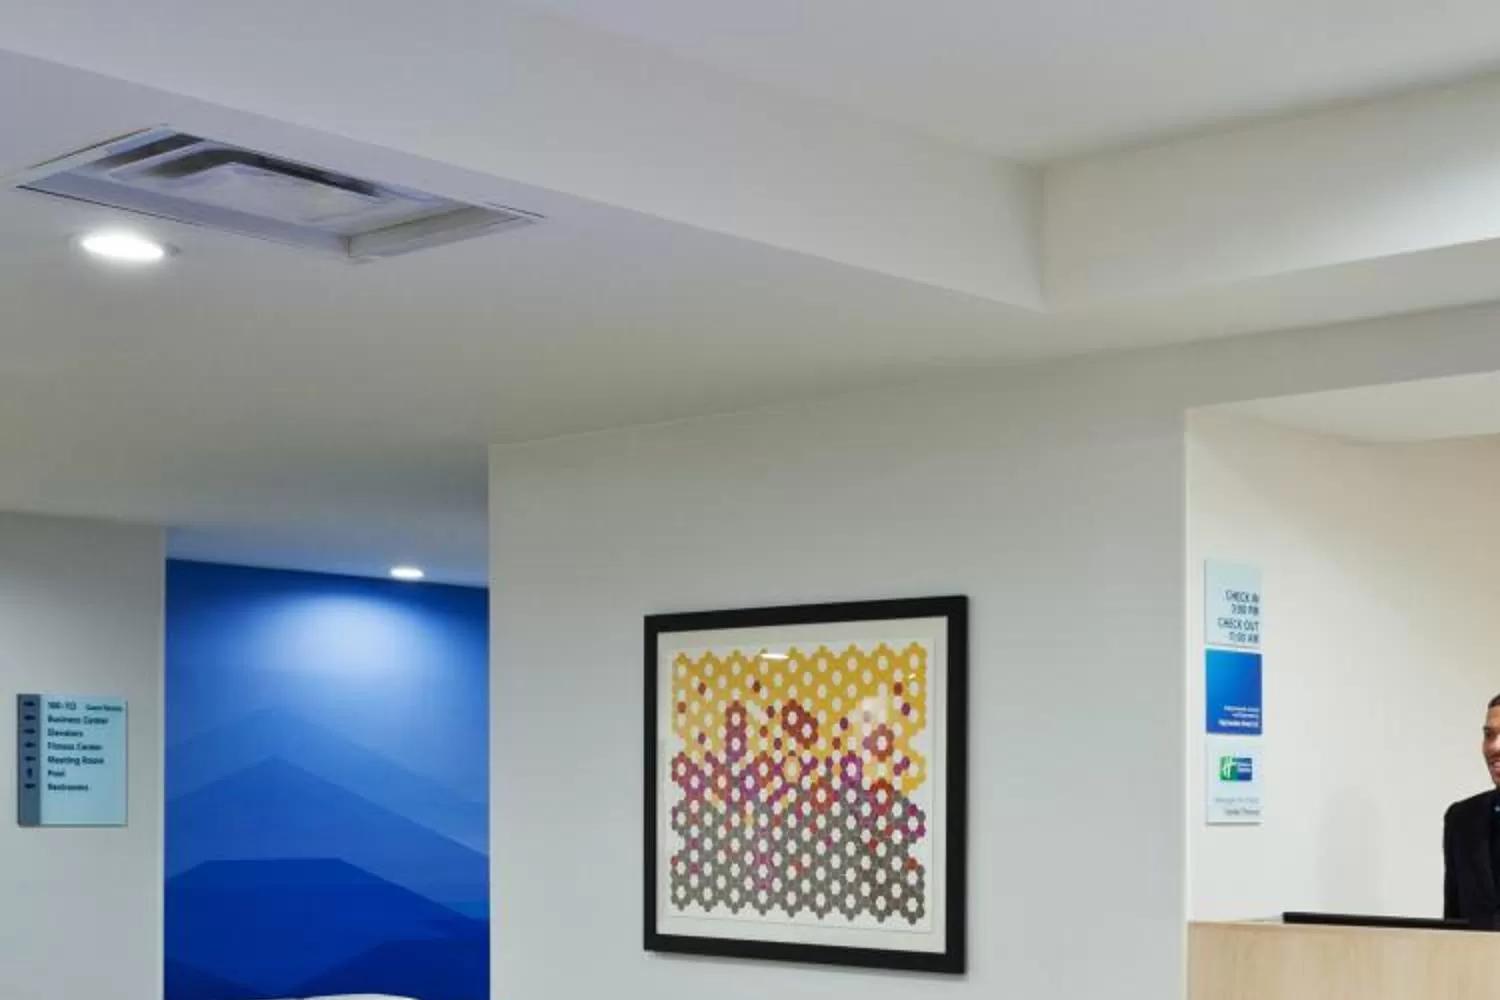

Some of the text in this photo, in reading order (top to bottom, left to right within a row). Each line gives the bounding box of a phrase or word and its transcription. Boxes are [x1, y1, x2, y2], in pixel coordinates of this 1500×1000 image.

[1223, 590, 1249, 602] CHECK
[1217, 617, 1260, 632] CHECK OUT
[47, 728, 84, 737] Elevators
[47, 755, 81, 766] Meeting
